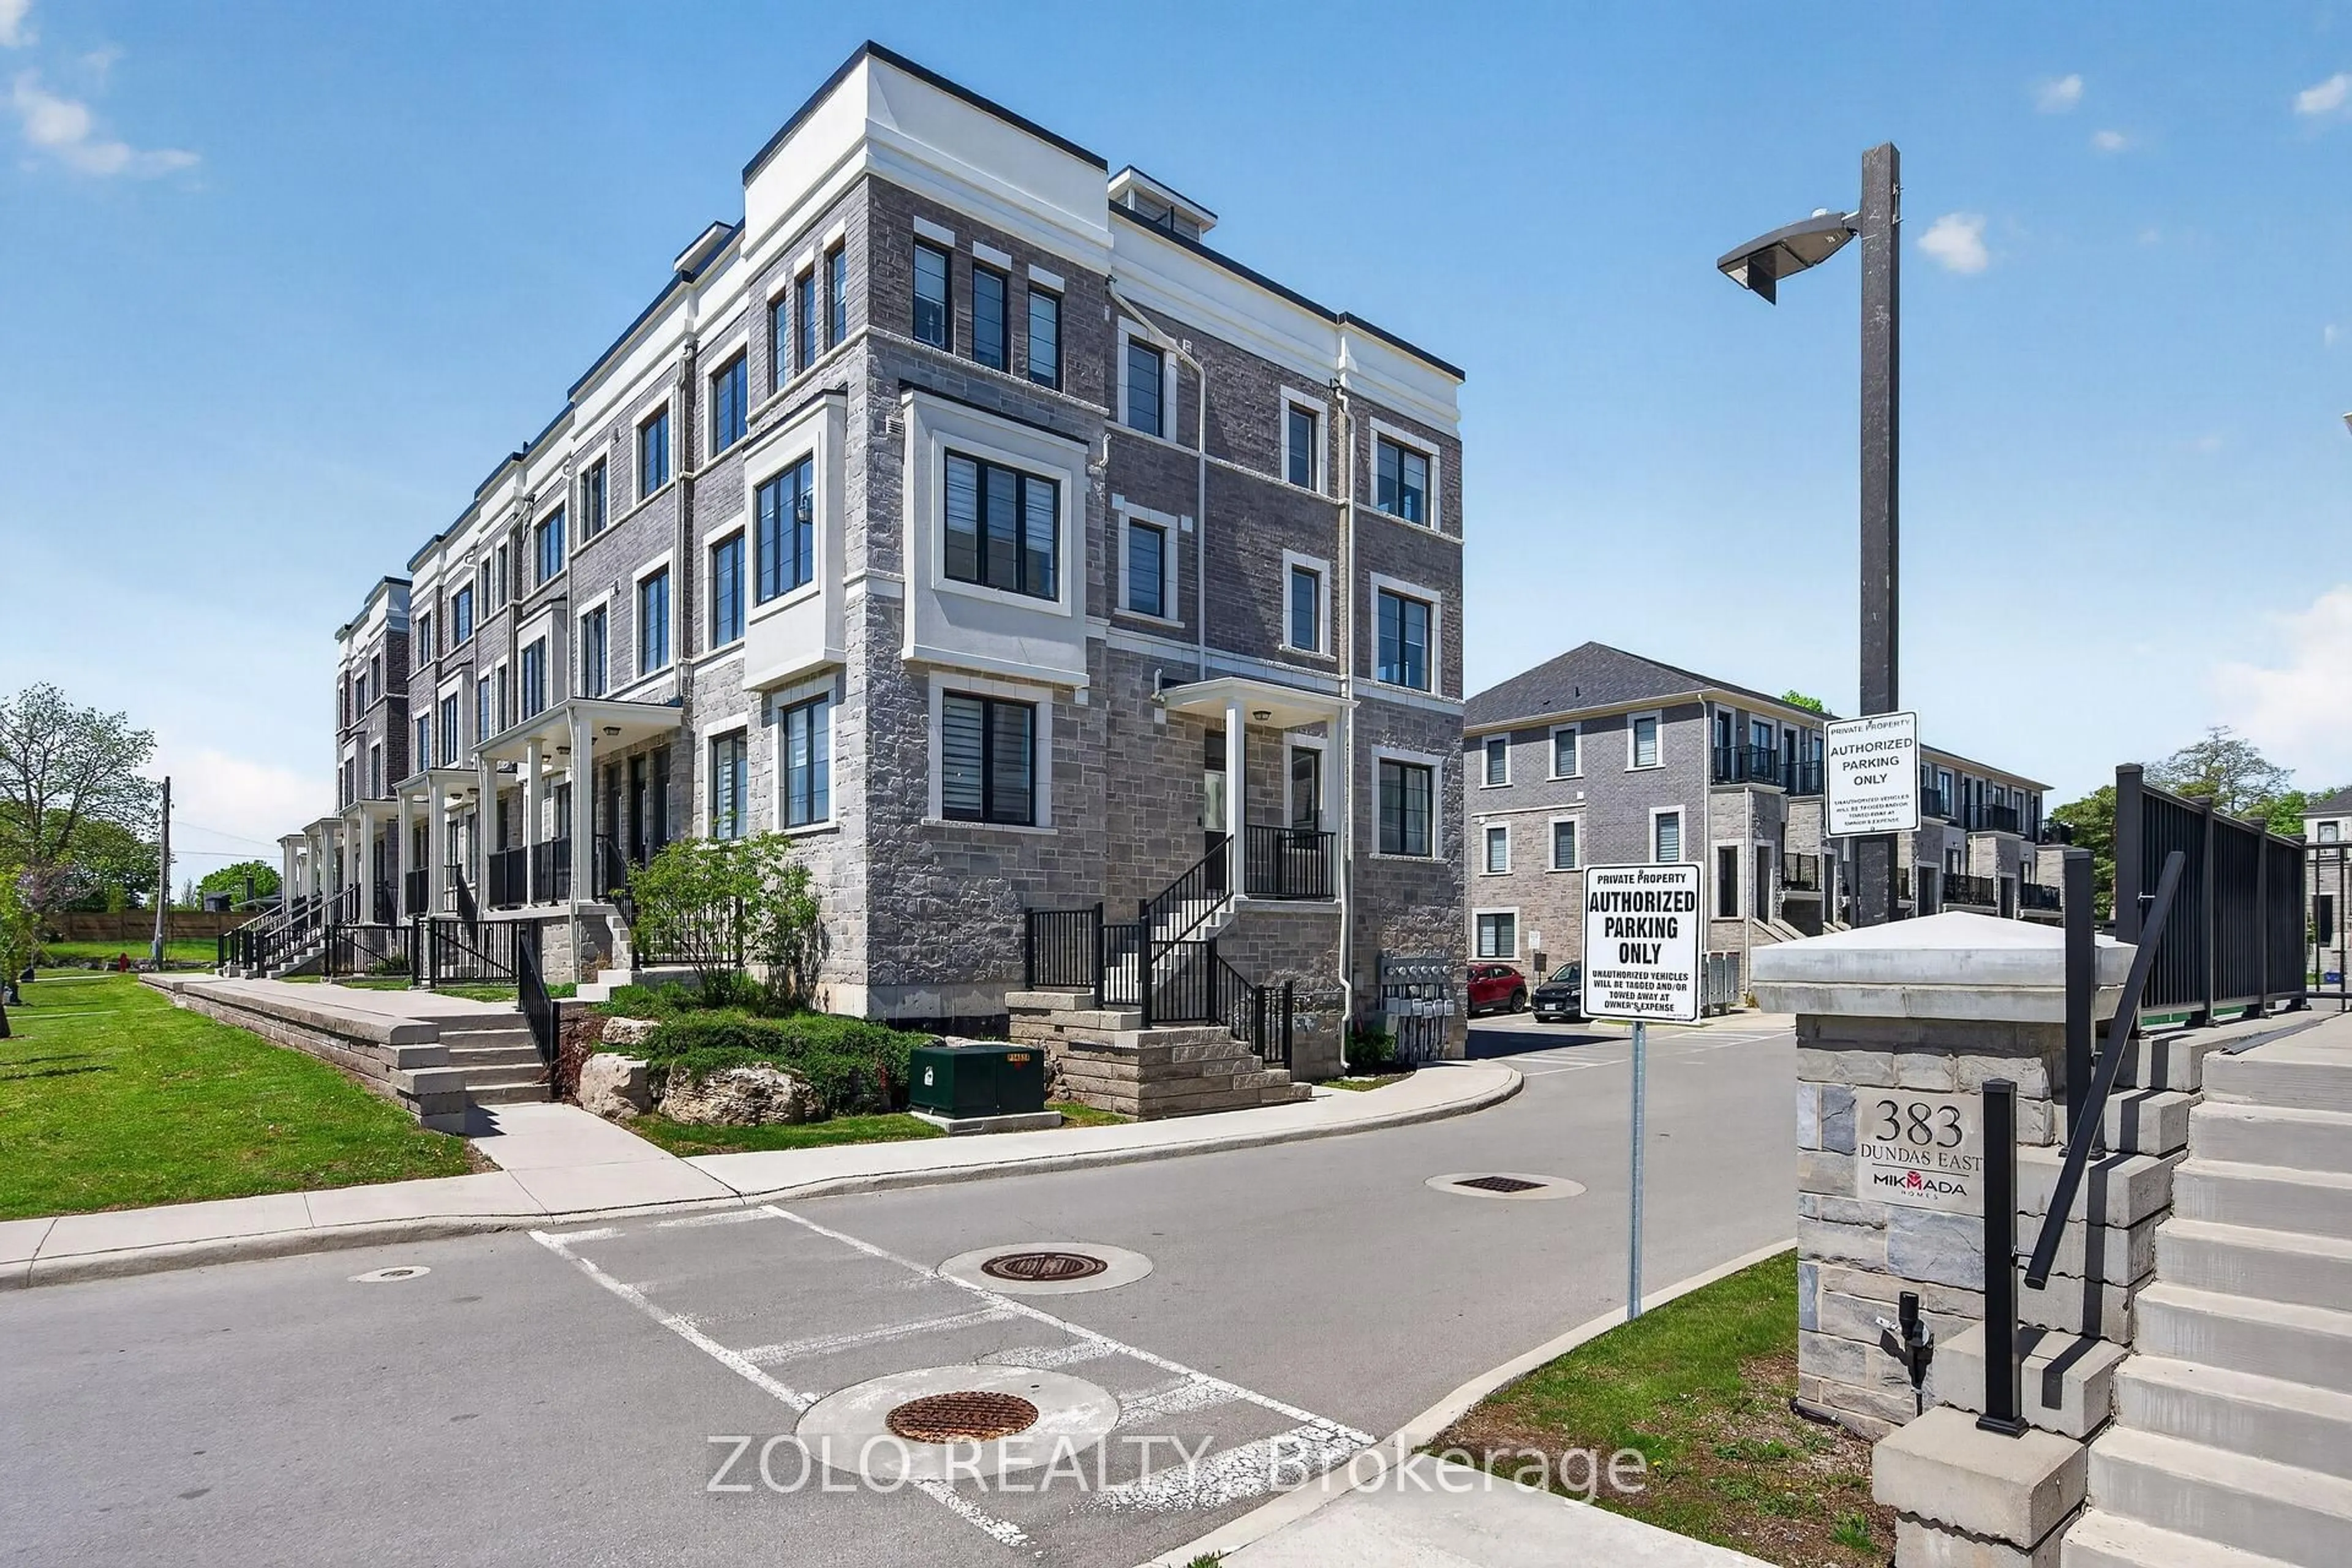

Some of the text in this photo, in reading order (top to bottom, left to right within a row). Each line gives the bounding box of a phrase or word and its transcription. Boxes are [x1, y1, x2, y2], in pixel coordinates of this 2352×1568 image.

[1831, 719, 1910, 735] PRIVATE PROPERTY
[1830, 737, 1913, 756] AUTHORIZED
[1842, 756, 1899, 771] PARKING
[1853, 774, 1887, 785] ONLY
[1597, 873, 1686, 884] PRIVATE PROPERTY
[1589, 891, 1695, 912] AUTHORIZED
[1605, 917, 1678, 938] PARKING
[1619, 943, 1662, 964] ONLY
[1593, 970, 1689, 981] UNAUTHORIZED VEHICLES
[1626, 981, 1654, 990] TAGGED
[1656, 982, 1687, 991] AND/OR
[1609, 991, 1635, 1000] TOWED
[1637, 992, 1658, 1001] AWAY
[1605, 1001, 1675, 1011] OWNER'S EXPENSE
[1876, 1100, 1962, 1148] 383
[1861, 1144, 1983, 1171] DUNDAS EAST
[1874, 1171, 1967, 1196] MIKMADA
[1901, 1191, 1938, 1200] HOMES
